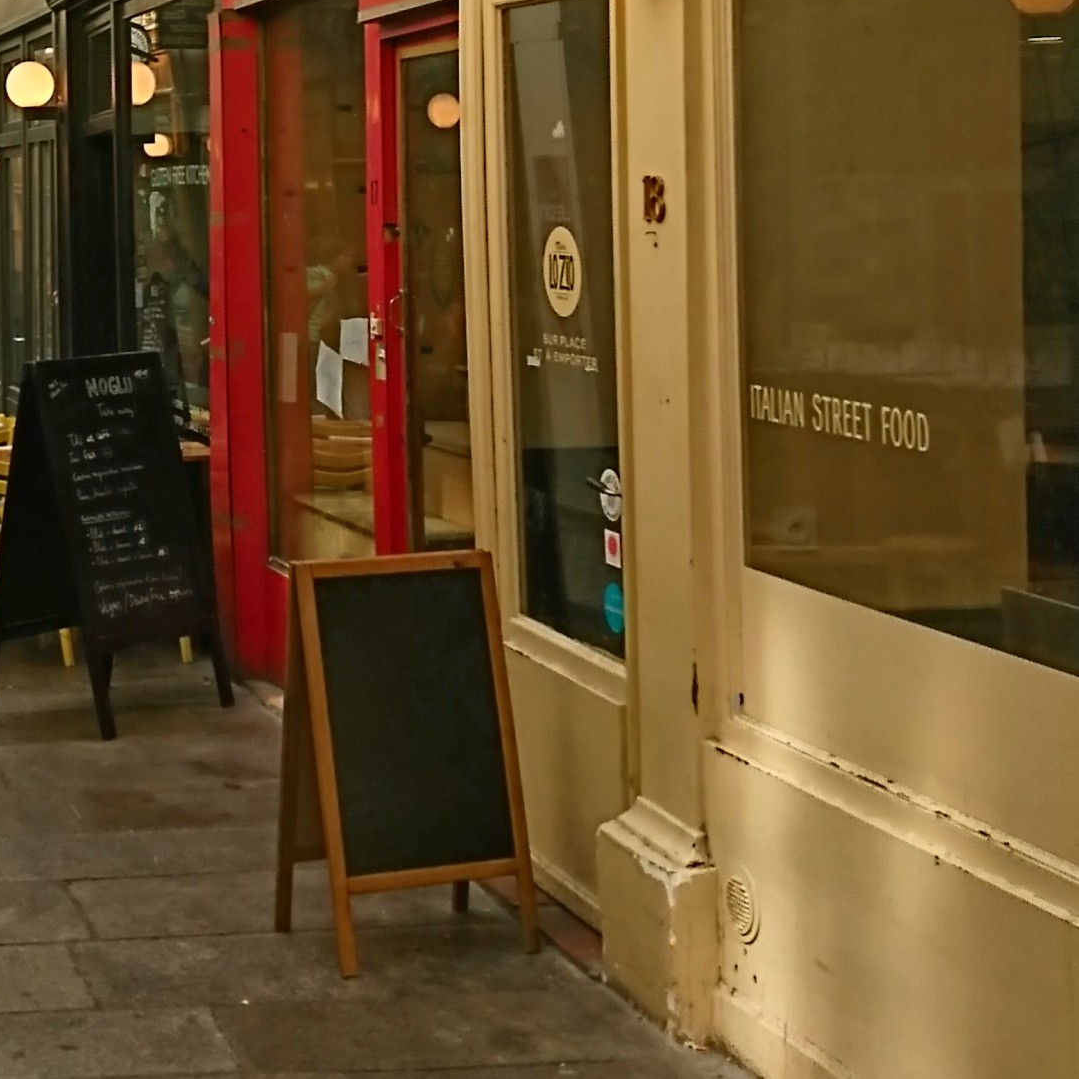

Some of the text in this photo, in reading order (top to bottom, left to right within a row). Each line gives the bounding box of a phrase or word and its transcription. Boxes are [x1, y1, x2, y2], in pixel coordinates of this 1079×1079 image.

[85, 375, 133, 398] NOGLU
[750, 384, 930, 452] ITALIAN STREET FOOD
